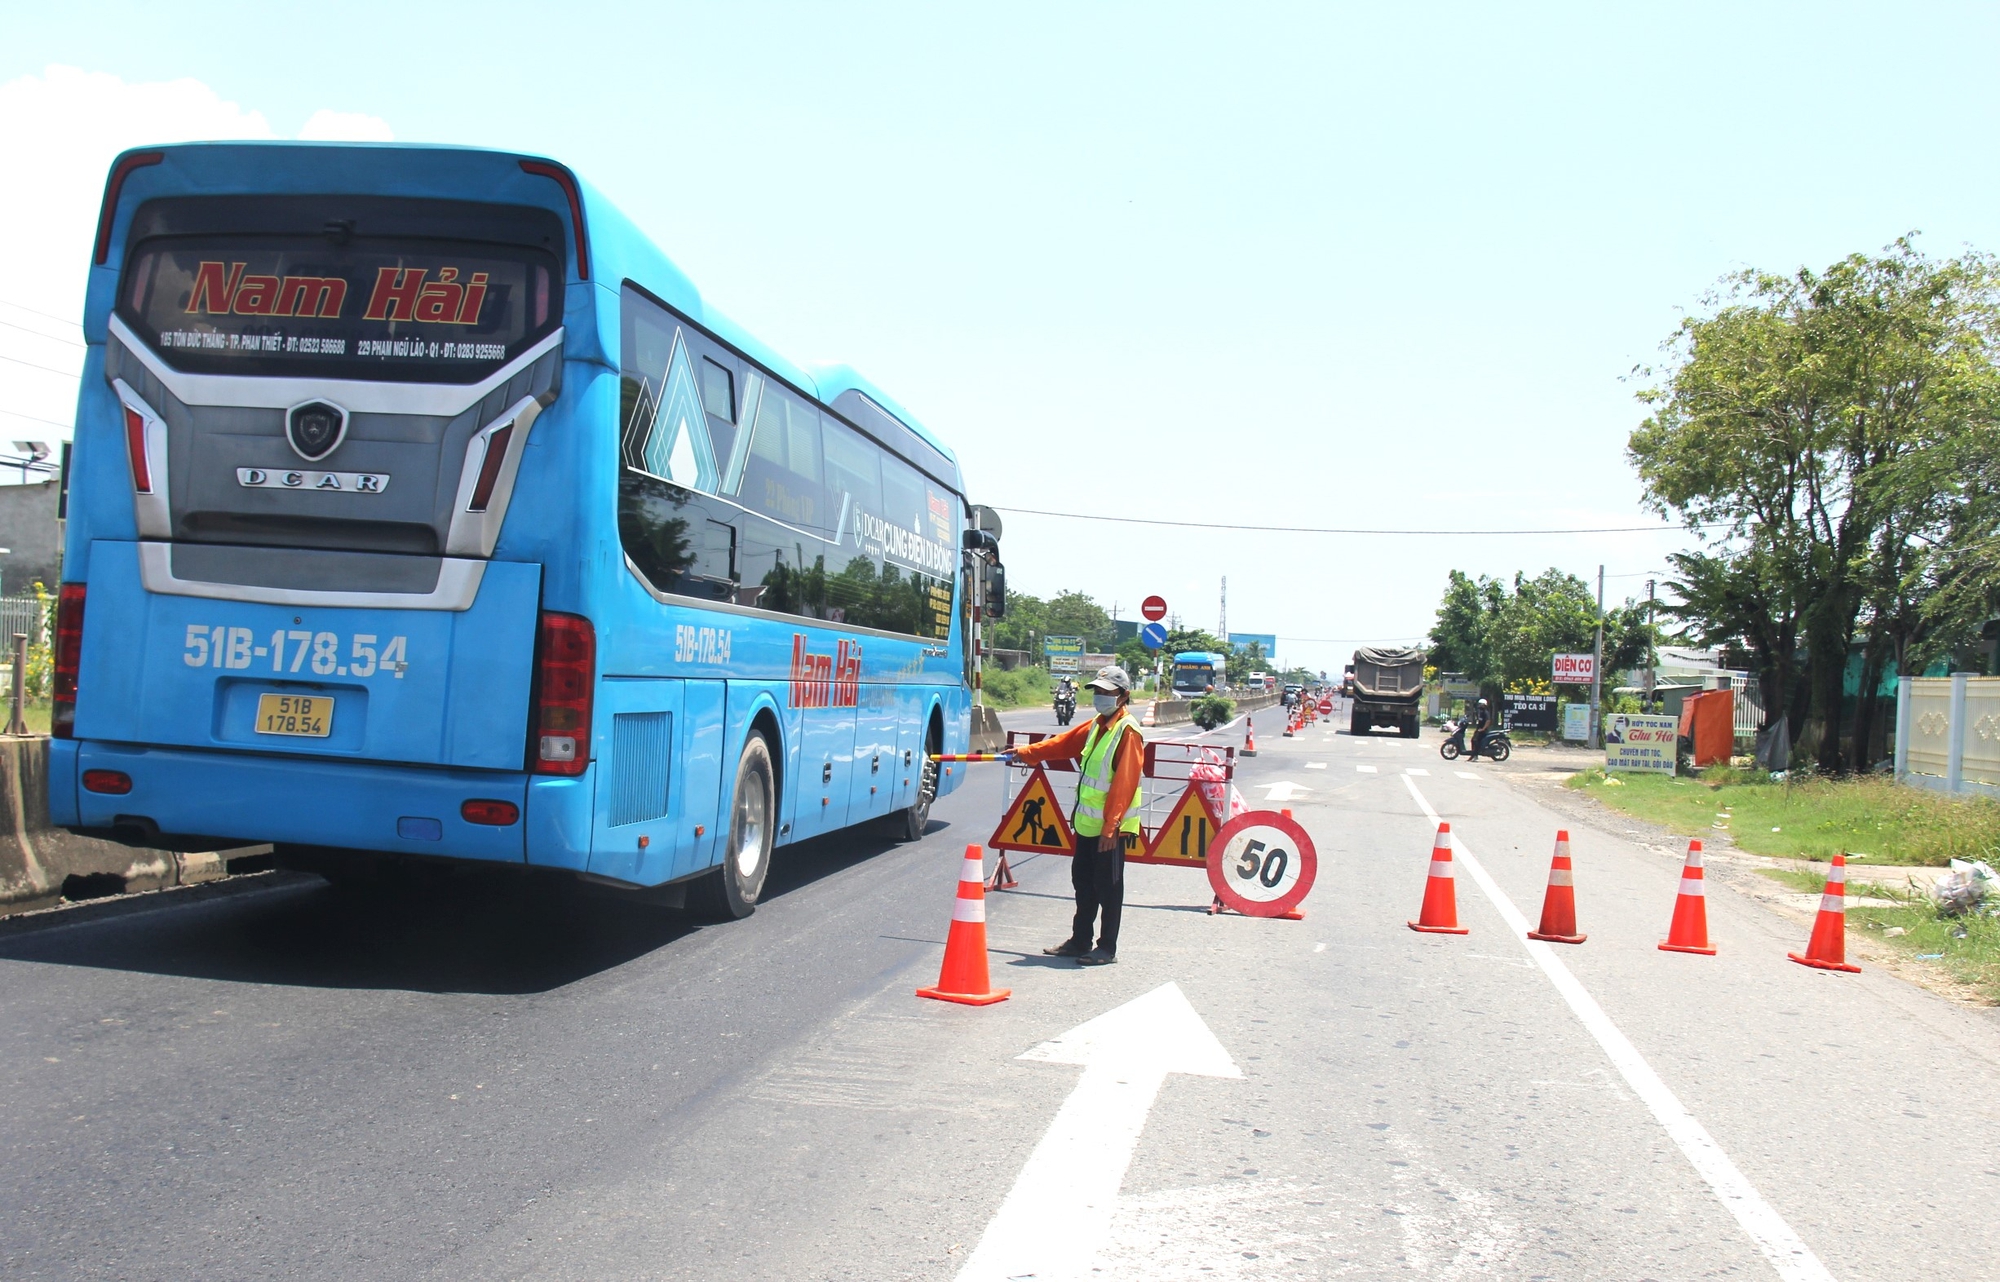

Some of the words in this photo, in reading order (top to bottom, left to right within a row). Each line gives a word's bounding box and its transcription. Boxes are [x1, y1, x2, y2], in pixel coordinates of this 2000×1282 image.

[184, 261, 348, 318] Nam
[362, 267, 489, 325] Hải
[230, 334, 240, 350] TP.
[241, 335, 260, 350] PHAN
[262, 331, 282, 351] THIẾT
[287, 337, 298, 352] ĐT:
[358, 340, 371, 356] 229
[371, 340, 392, 360] PHẠM
[430, 342, 439, 358] Q1
[444, 343, 456, 358] ĐT:
[457, 343, 474, 359] 0283
[243, 469, 379, 491] DCAR
[864, 513, 884, 542] DCAR
[884, 522, 908, 559] CUNG
[926, 538, 934, 569] DI
[183, 624, 408, 679] 51B-178.54
[675, 624, 731, 664] 51B-178.54
[787, 632, 832, 709] Nam
[832, 638, 863, 708] Hải
[1555, 655, 1576, 676] ĐIỆN
[1579, 659, 1592, 673] CƠ
[280, 697, 311, 715] 51B
[1528, 703, 1537, 711] CA
[267, 714, 322, 734] 178.54
[1659, 721, 1673, 729] NAM
[1629, 728, 1652, 741] Thu
[1655, 729, 1675, 743] Hà
[1236, 838, 1288, 888] 50
